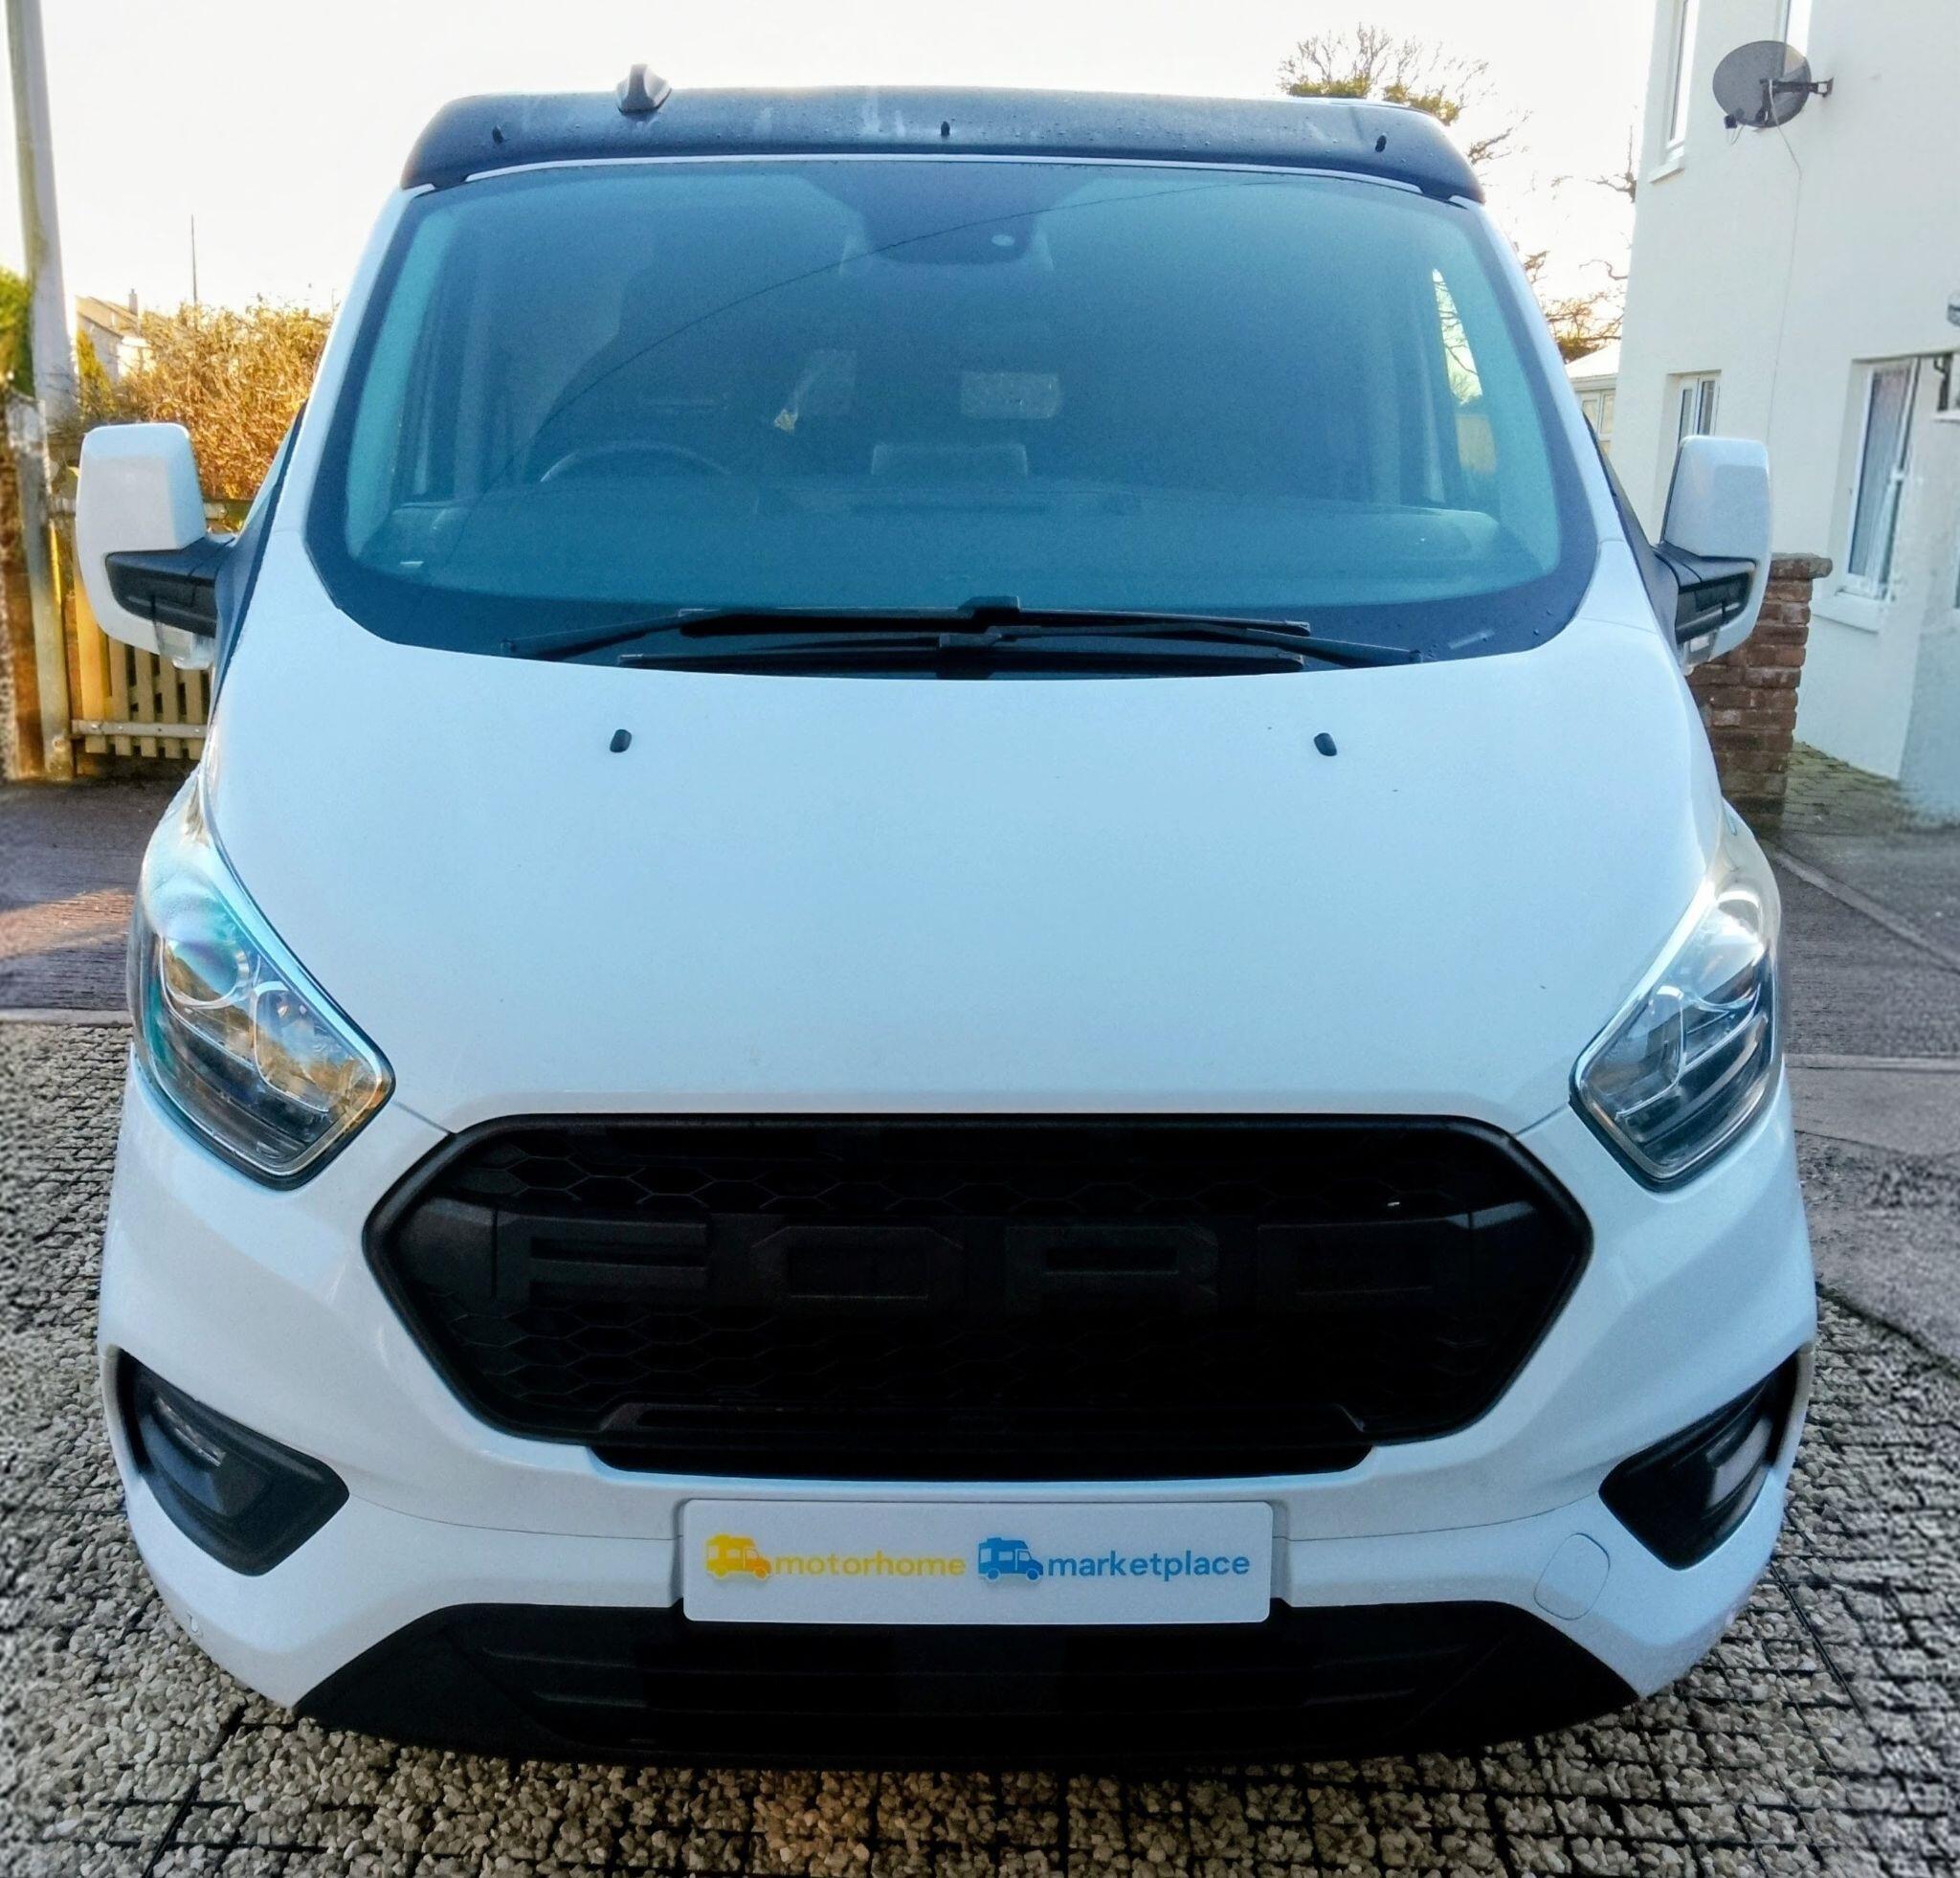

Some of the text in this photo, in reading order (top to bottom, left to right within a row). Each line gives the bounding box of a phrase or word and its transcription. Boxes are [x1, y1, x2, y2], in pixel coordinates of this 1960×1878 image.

[496, 1215, 1472, 1315] FORD
[775, 1550, 1251, 1581] motorhome marketplace
